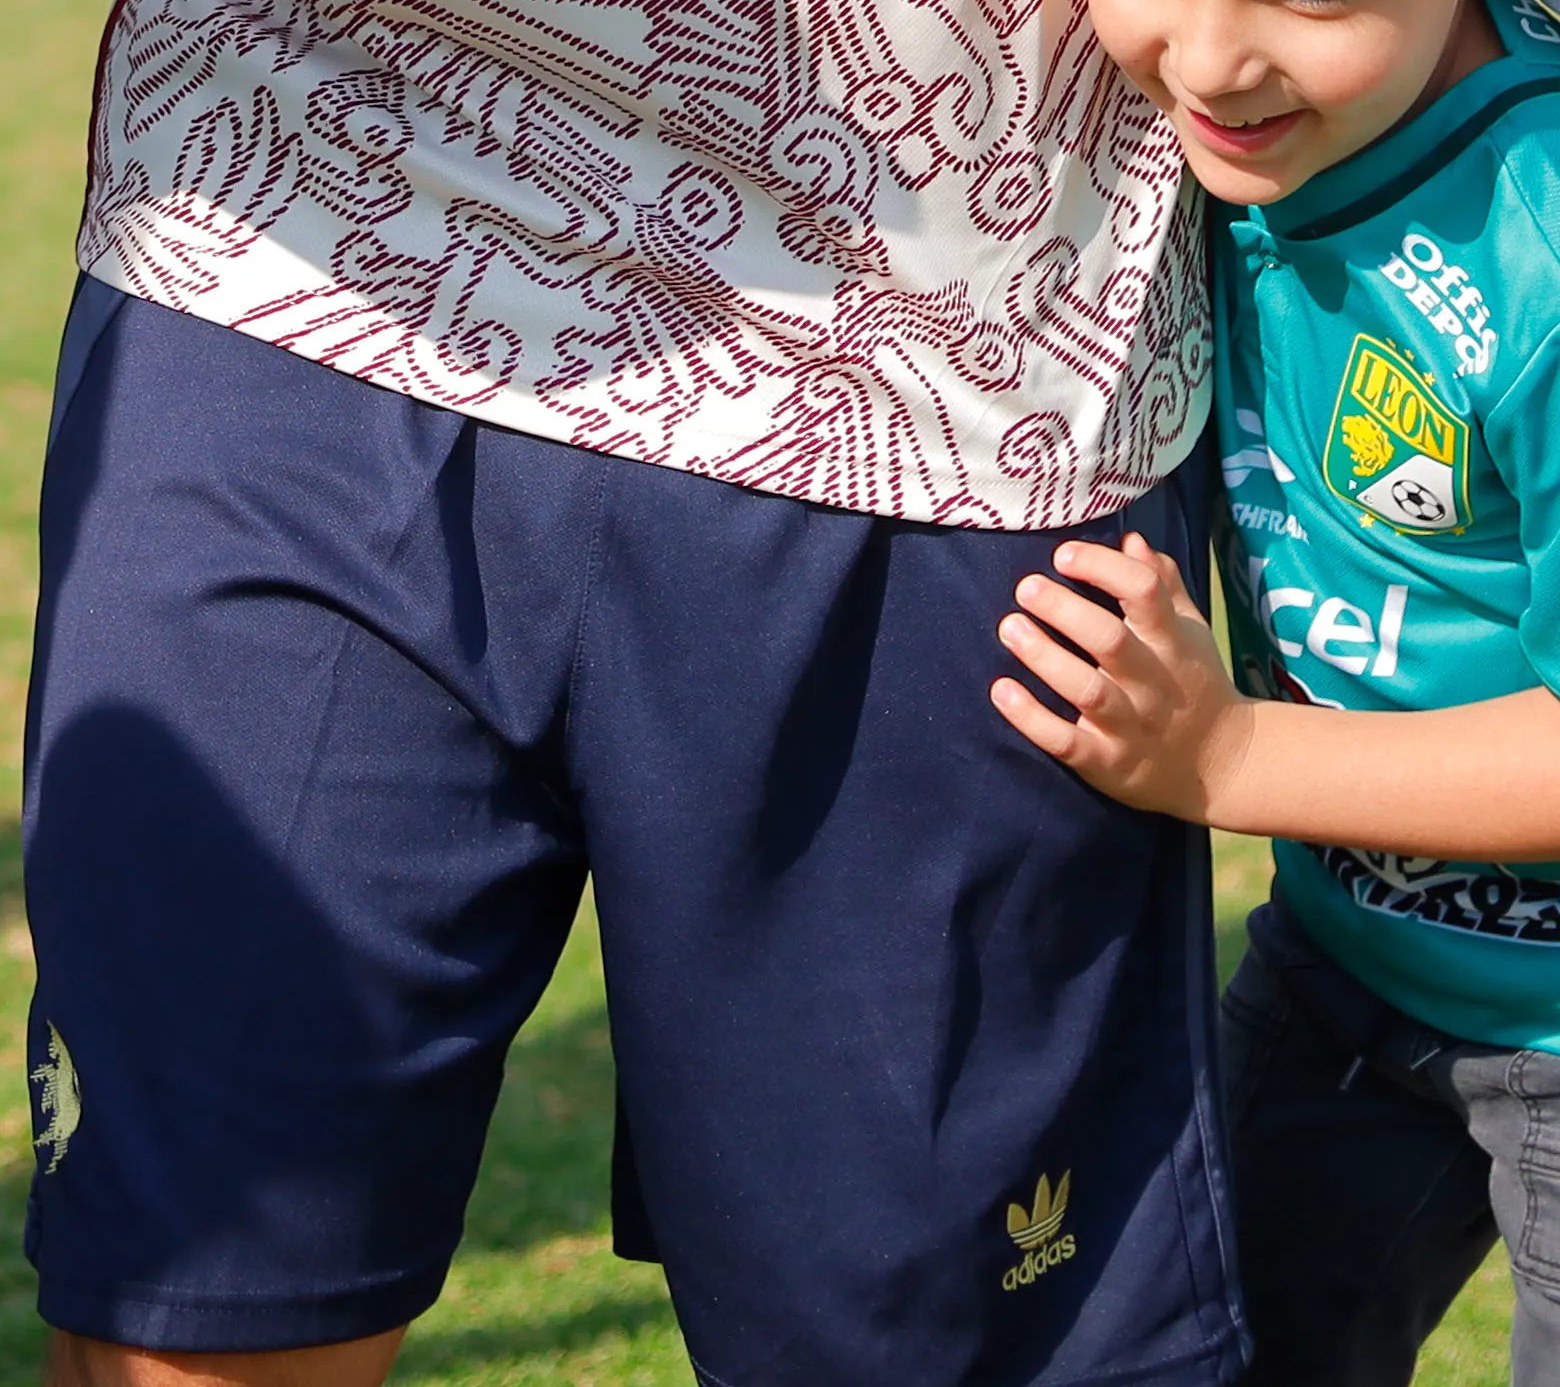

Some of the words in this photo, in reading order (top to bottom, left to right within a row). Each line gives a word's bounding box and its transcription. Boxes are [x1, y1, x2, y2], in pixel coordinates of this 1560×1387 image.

[1378, 251, 1481, 378] DEPO
[1355, 354, 1449, 456] LEON
[1001, 1233, 1076, 1291] adidas
